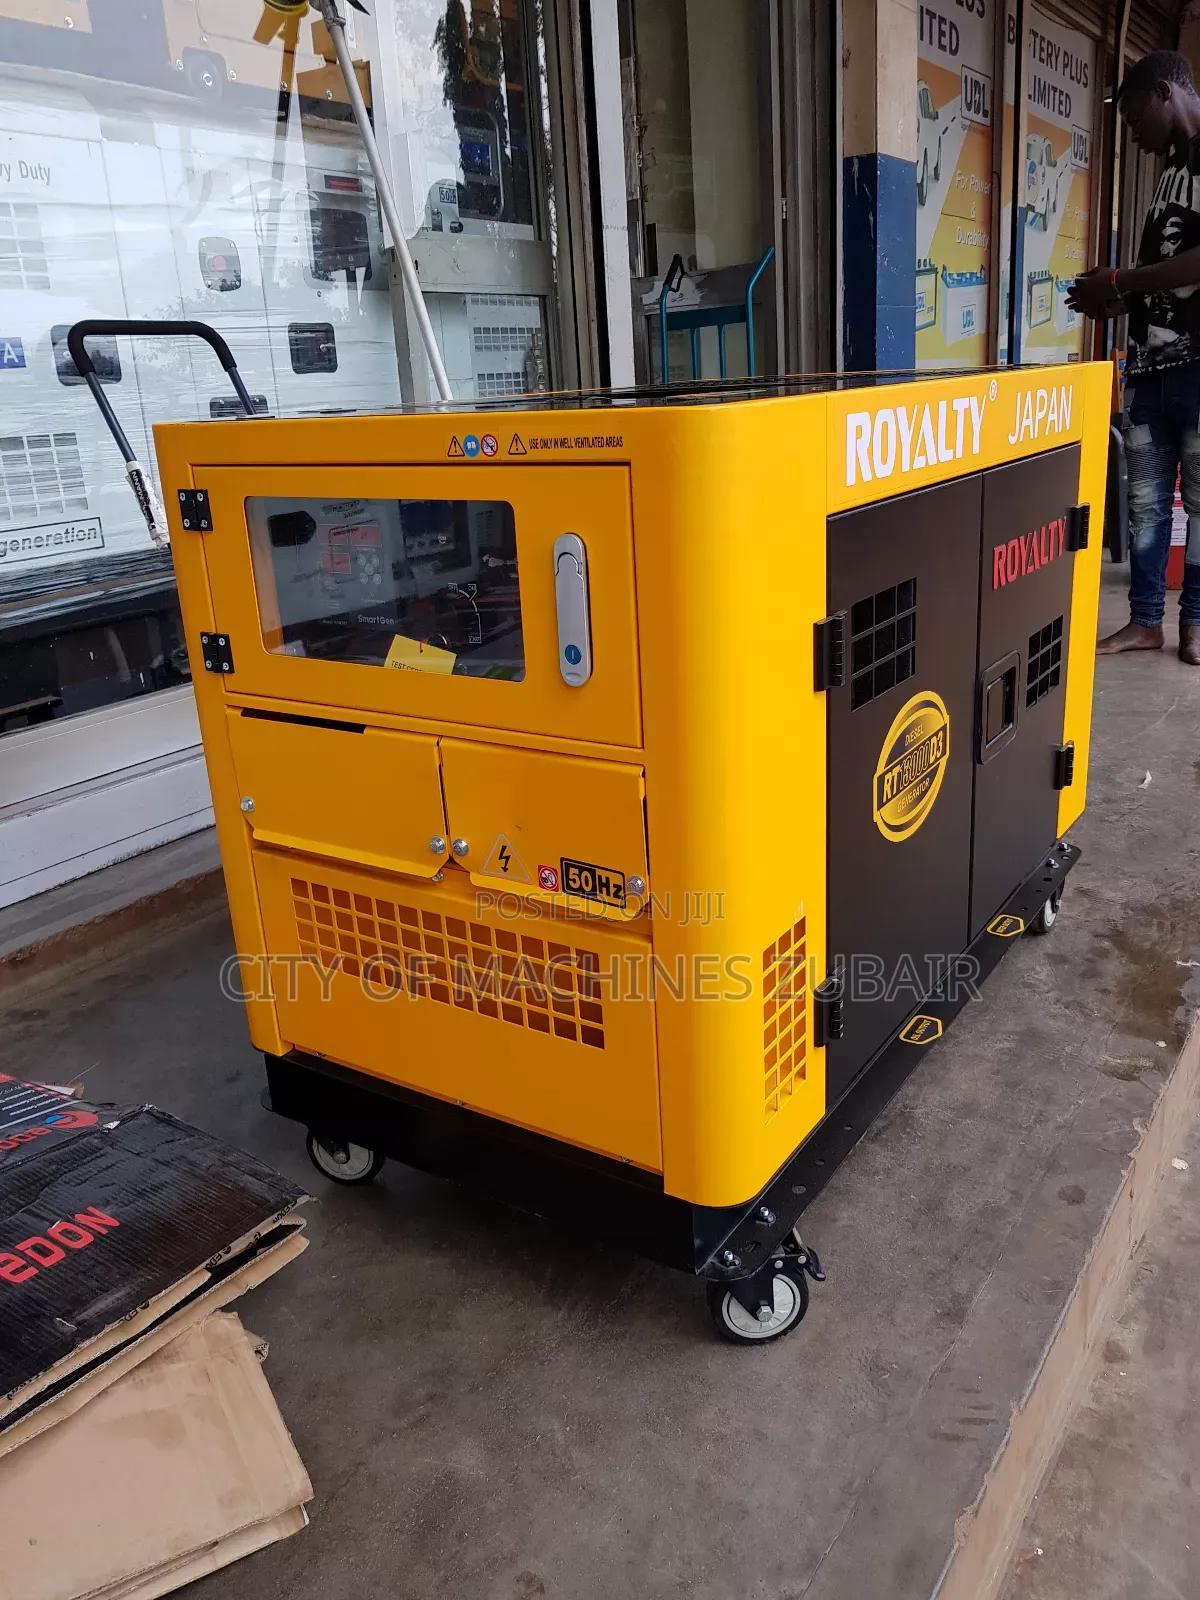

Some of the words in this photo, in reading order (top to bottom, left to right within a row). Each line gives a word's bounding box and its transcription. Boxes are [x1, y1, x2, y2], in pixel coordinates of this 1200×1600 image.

[1063, 50, 1089, 88] PLUS
[1028, 74, 1072, 119] IMITED
[18, 159, 51, 186] Duty
[956, 170, 968, 190] For
[957, 226, 989, 252] Durability
[1008, 384, 1073, 445] JAPAN
[528, 438, 538, 450] USE
[539, 438, 552, 450] ONLY
[552, 438, 559, 449] IN
[559, 437, 573, 449] WELL
[574, 437, 604, 449] VENTILATED
[605, 435, 623, 448] AREAS
[992, 516, 1067, 592] ROYALTY
[357, 614, 395, 626] SmartGen
[904, 723, 924, 747] DIESEL
[897, 777, 930, 813] GENERATOR
